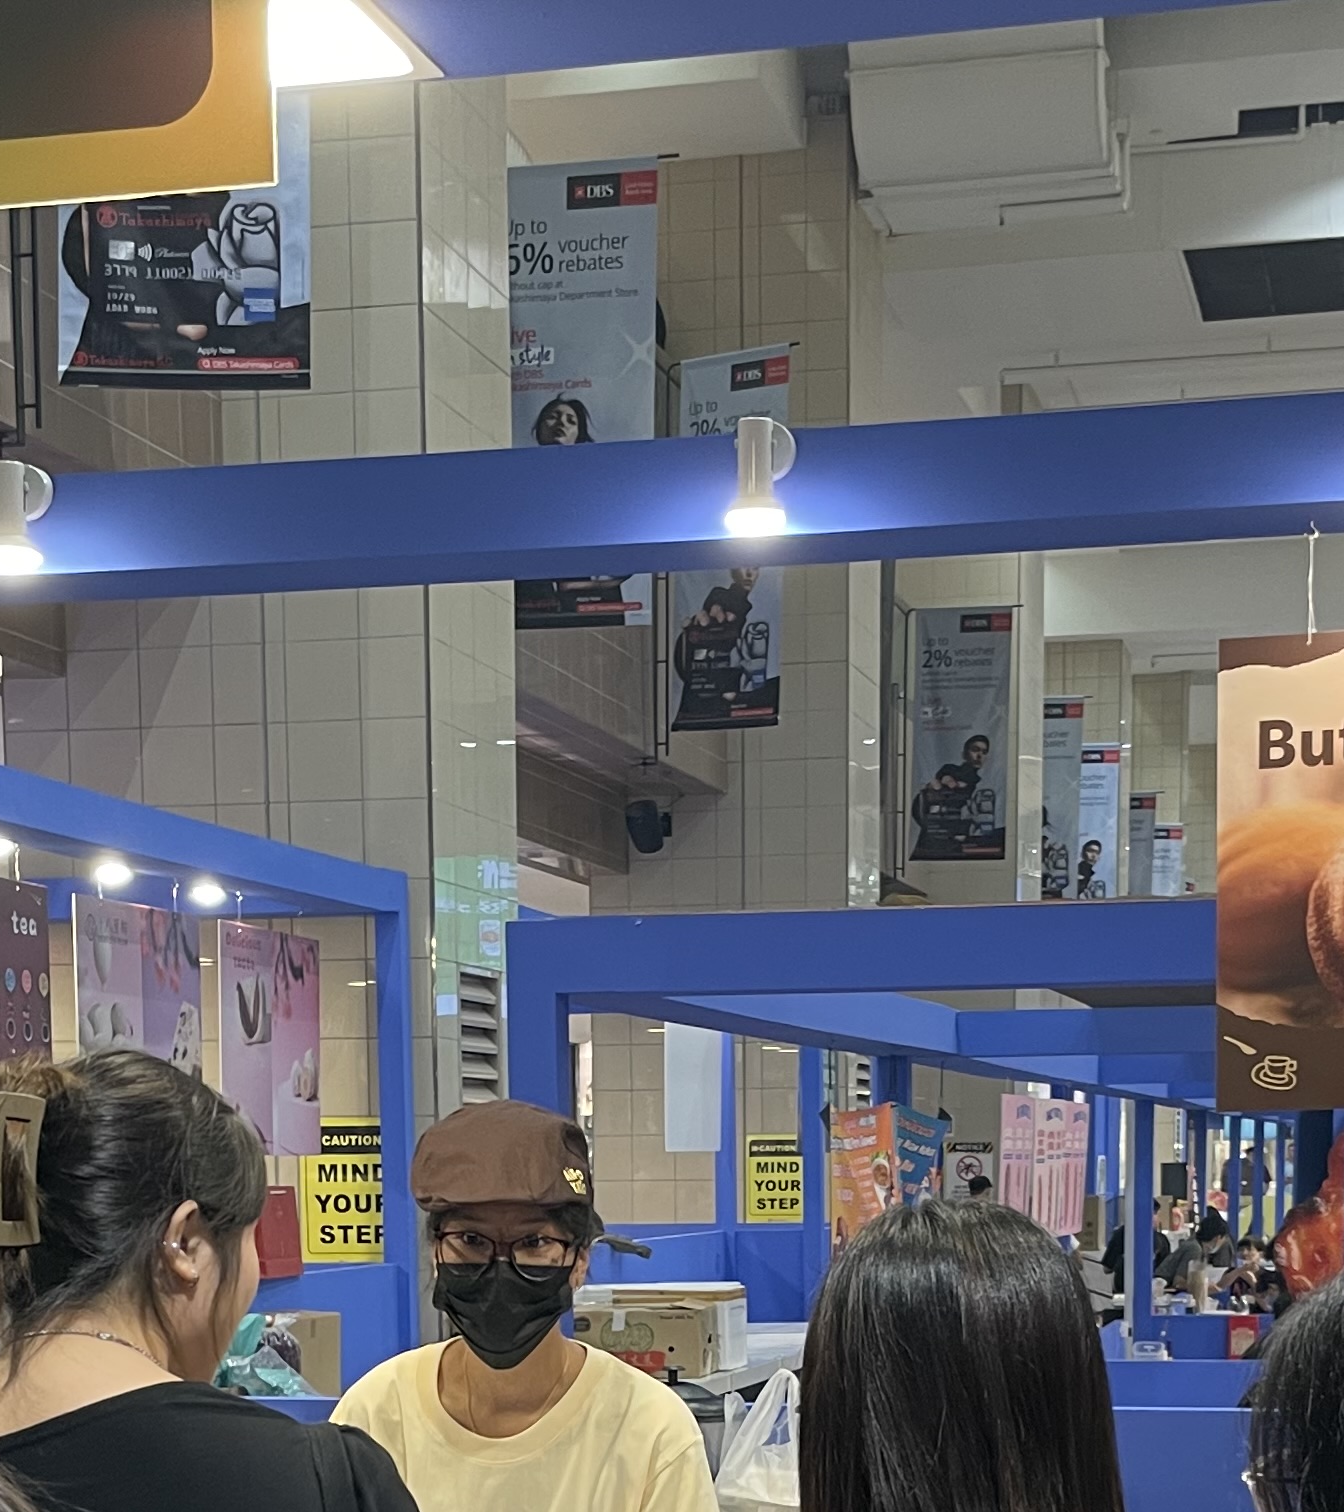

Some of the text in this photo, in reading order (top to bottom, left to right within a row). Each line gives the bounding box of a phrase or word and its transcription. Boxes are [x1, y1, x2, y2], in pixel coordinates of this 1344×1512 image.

[587, 184, 614, 199] DBS
[119, 211, 212, 231] Takashimaya
[531, 220, 547, 235] to
[558, 233, 629, 253] voucher
[559, 255, 623, 273] rebates
[559, 288, 612, 300] Department
[615, 287, 638, 298] Store
[511, 326, 537, 344] ive
[519, 344, 551, 367] style
[922, 650, 952, 668] 2%
[11, 910, 37, 936] tea
[321, 1135, 381, 1146] CAUTION
[759, 1144, 797, 1152] CAUTION
[756, 1162, 800, 1173] MIND
[754, 1180, 801, 1191] YOUR
[757, 1198, 800, 1210] STEP
